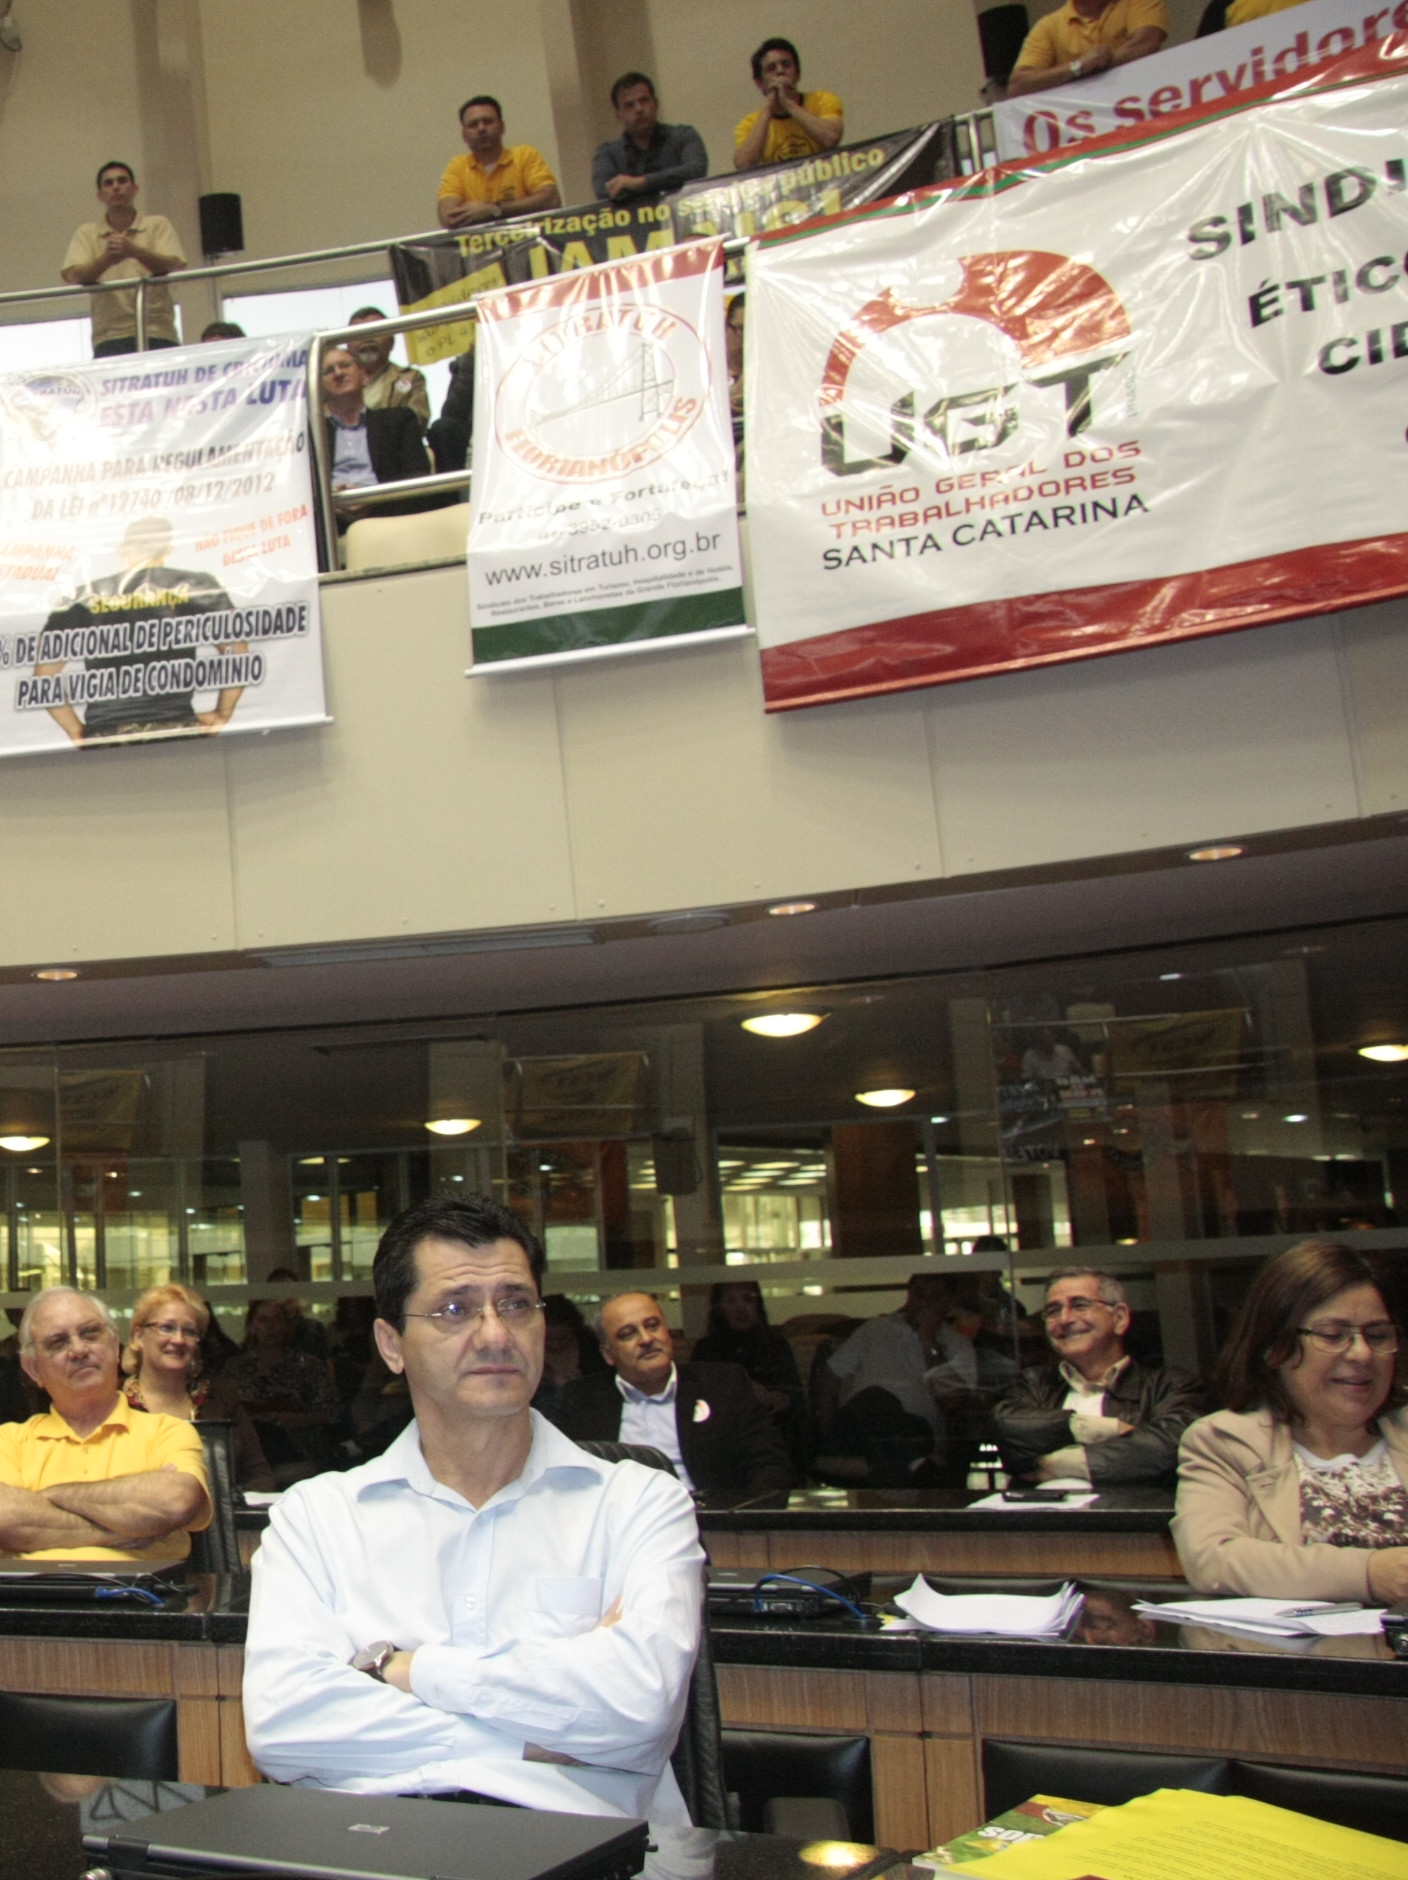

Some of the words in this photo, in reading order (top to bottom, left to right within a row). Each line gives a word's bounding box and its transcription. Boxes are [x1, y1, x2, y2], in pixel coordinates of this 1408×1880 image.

[1023, 109, 1096, 153] Os
[454, 203, 631, 258] Terceirização
[636, 203, 671, 224] no
[784, 147, 886, 195] público
[1248, 249, 1408, 328] ÉTIC
[100, 368, 189, 397] SITRATUH
[194, 365, 217, 384] DE
[100, 399, 154, 427] ESTA
[2, 463, 95, 490] CAMPANHA
[100, 457, 147, 482] PARA
[821, 485, 921, 516] UNIÃO
[935, 460, 1048, 495] GERAL
[1064, 441, 1141, 469] DOS
[32, 497, 55, 521] DA
[277, 503, 309, 528] FORA
[829, 466, 1137, 539] TRABALHADORES
[261, 533, 292, 554] LUTA
[485, 531, 722, 587] www.sitratuh.org.br
[822, 533, 943, 570] SANTA
[952, 494, 1150, 546] CATARINA
[16, 636, 36, 664] DE
[41, 623, 132, 662] ADICIONAL
[136, 620, 159, 650] DE
[162, 605, 307, 643] PERICULOSIDADE
[16, 678, 62, 707] PARA
[67, 668, 116, 701] VIGIA
[120, 665, 142, 695] DE
[146, 649, 264, 693] CONDOMÍNIO
